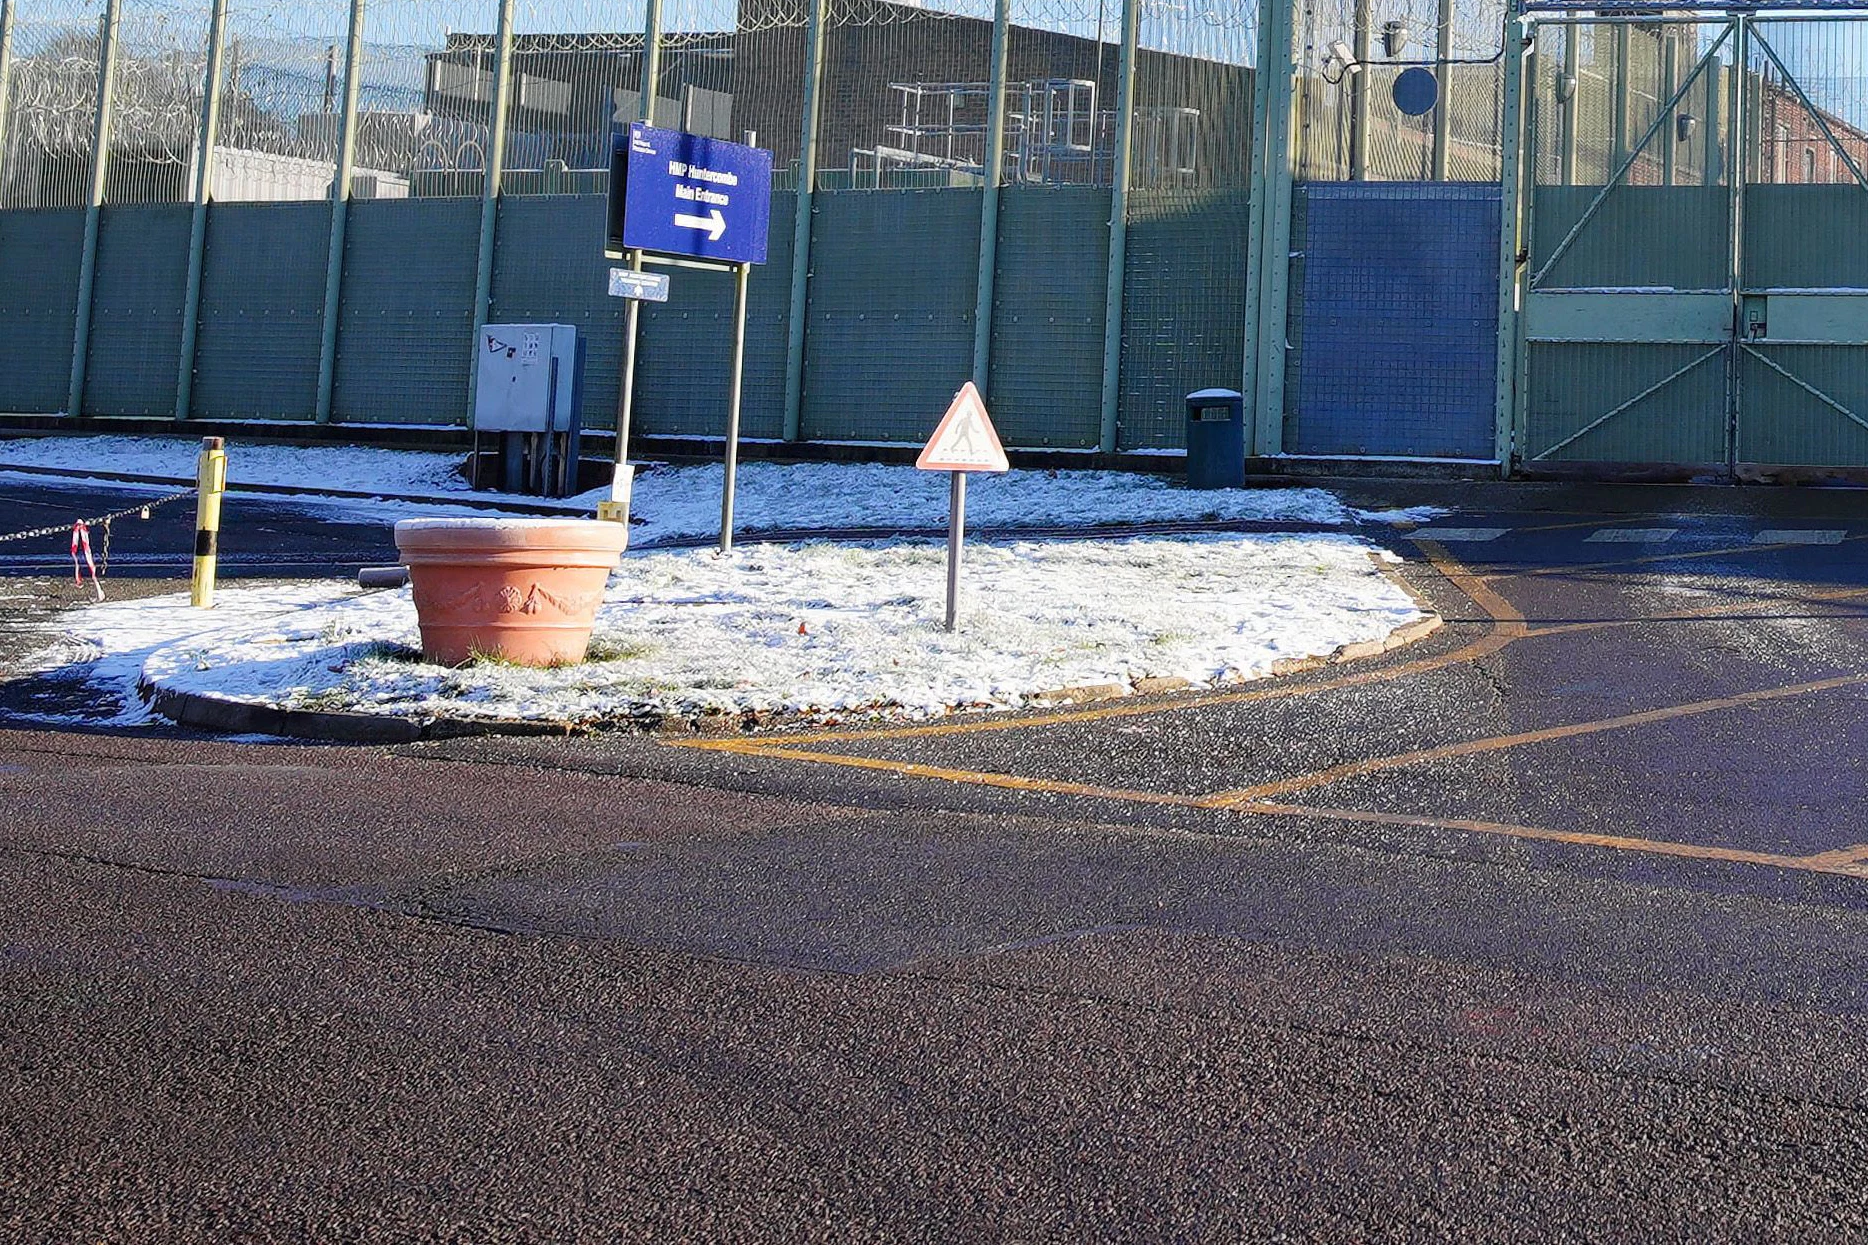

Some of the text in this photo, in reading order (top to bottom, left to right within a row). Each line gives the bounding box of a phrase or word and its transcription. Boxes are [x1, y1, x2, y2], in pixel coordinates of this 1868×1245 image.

[668, 160, 688, 177] HMP
[675, 183, 730, 206] Main Entrance
